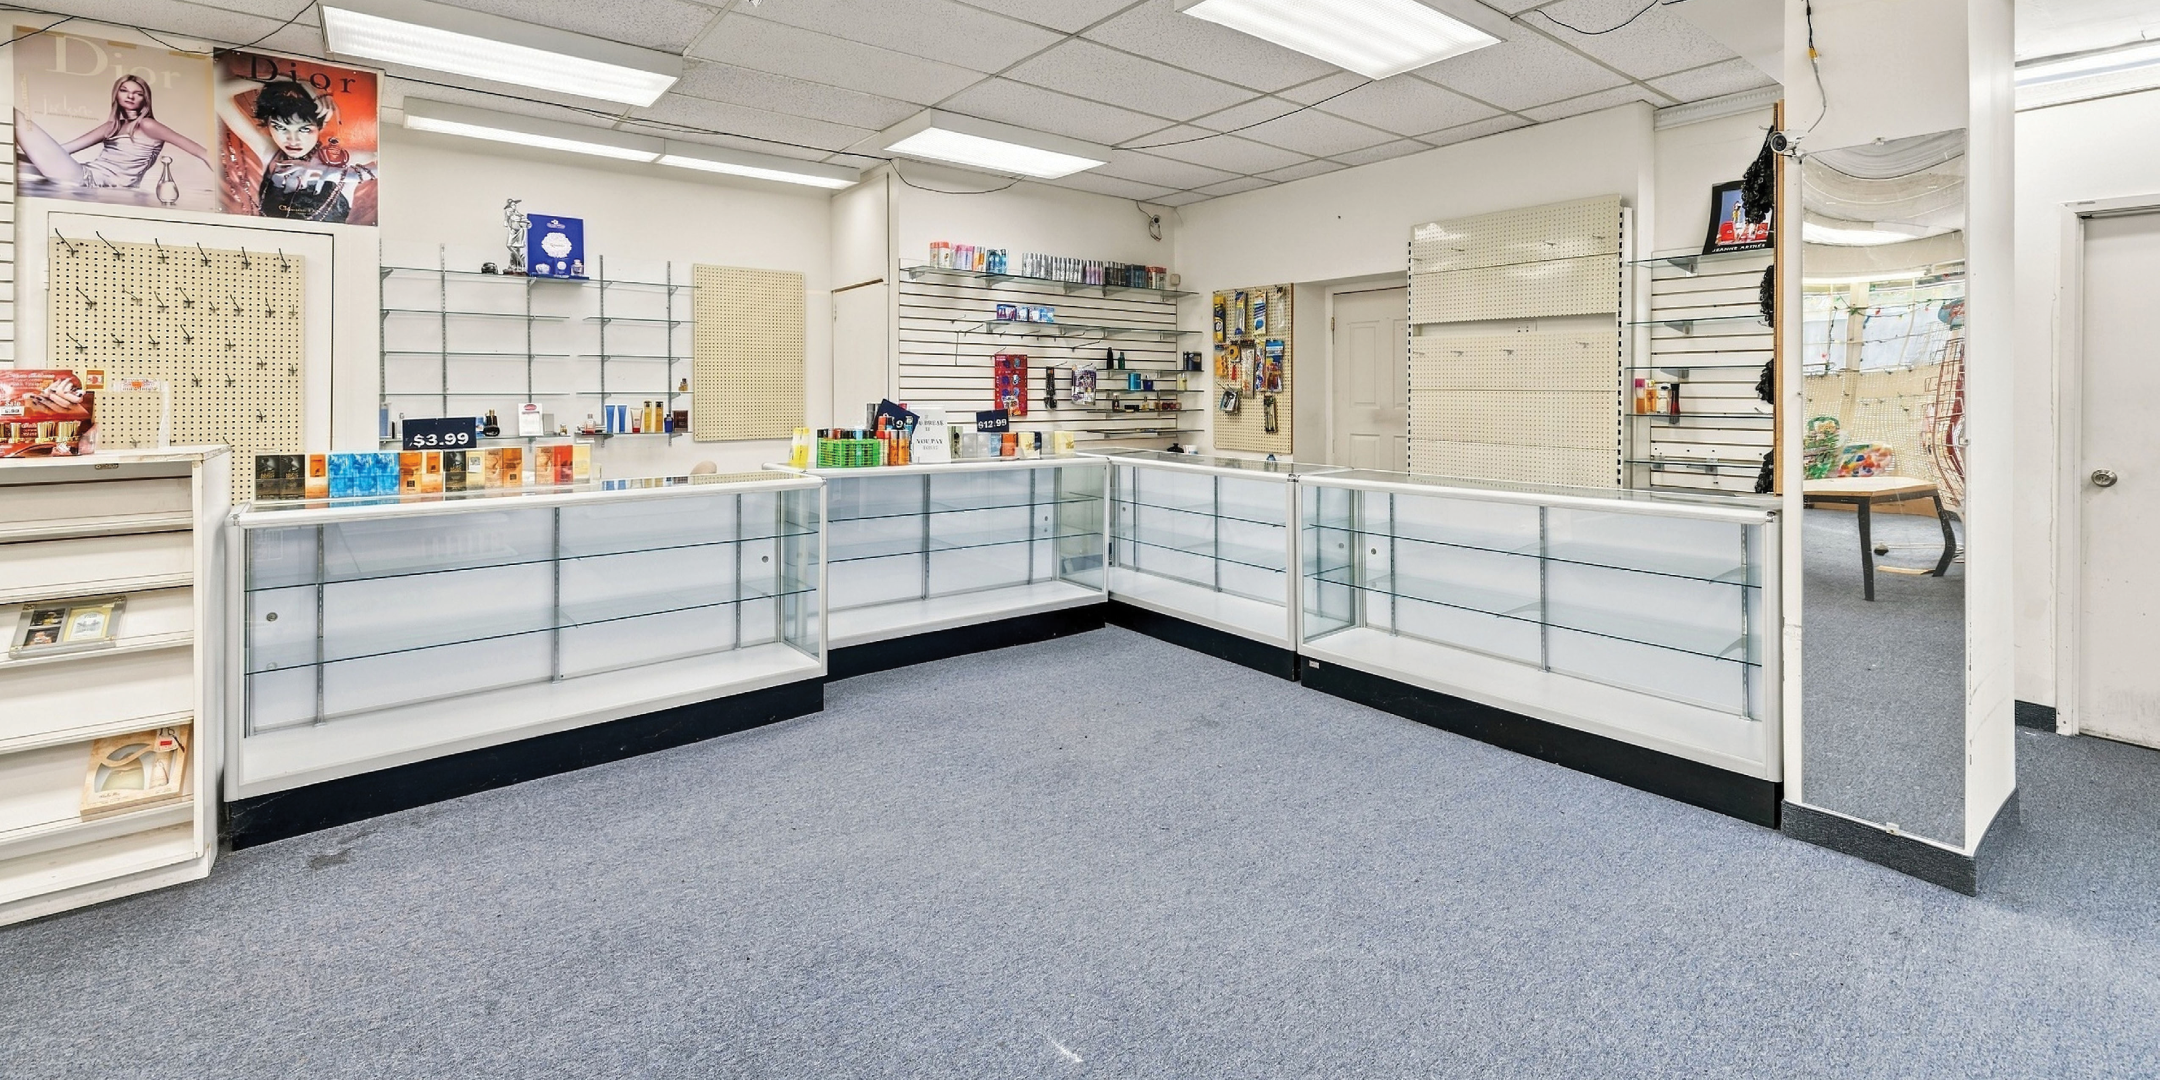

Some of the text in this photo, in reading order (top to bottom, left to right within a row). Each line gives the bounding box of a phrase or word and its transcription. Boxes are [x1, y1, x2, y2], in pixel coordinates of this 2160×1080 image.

[46, 35, 181, 90] Dior
[249, 56, 356, 93] Dior
[978, 418, 1007, 429] $12.99
[413, 432, 469, 448] $3.99
